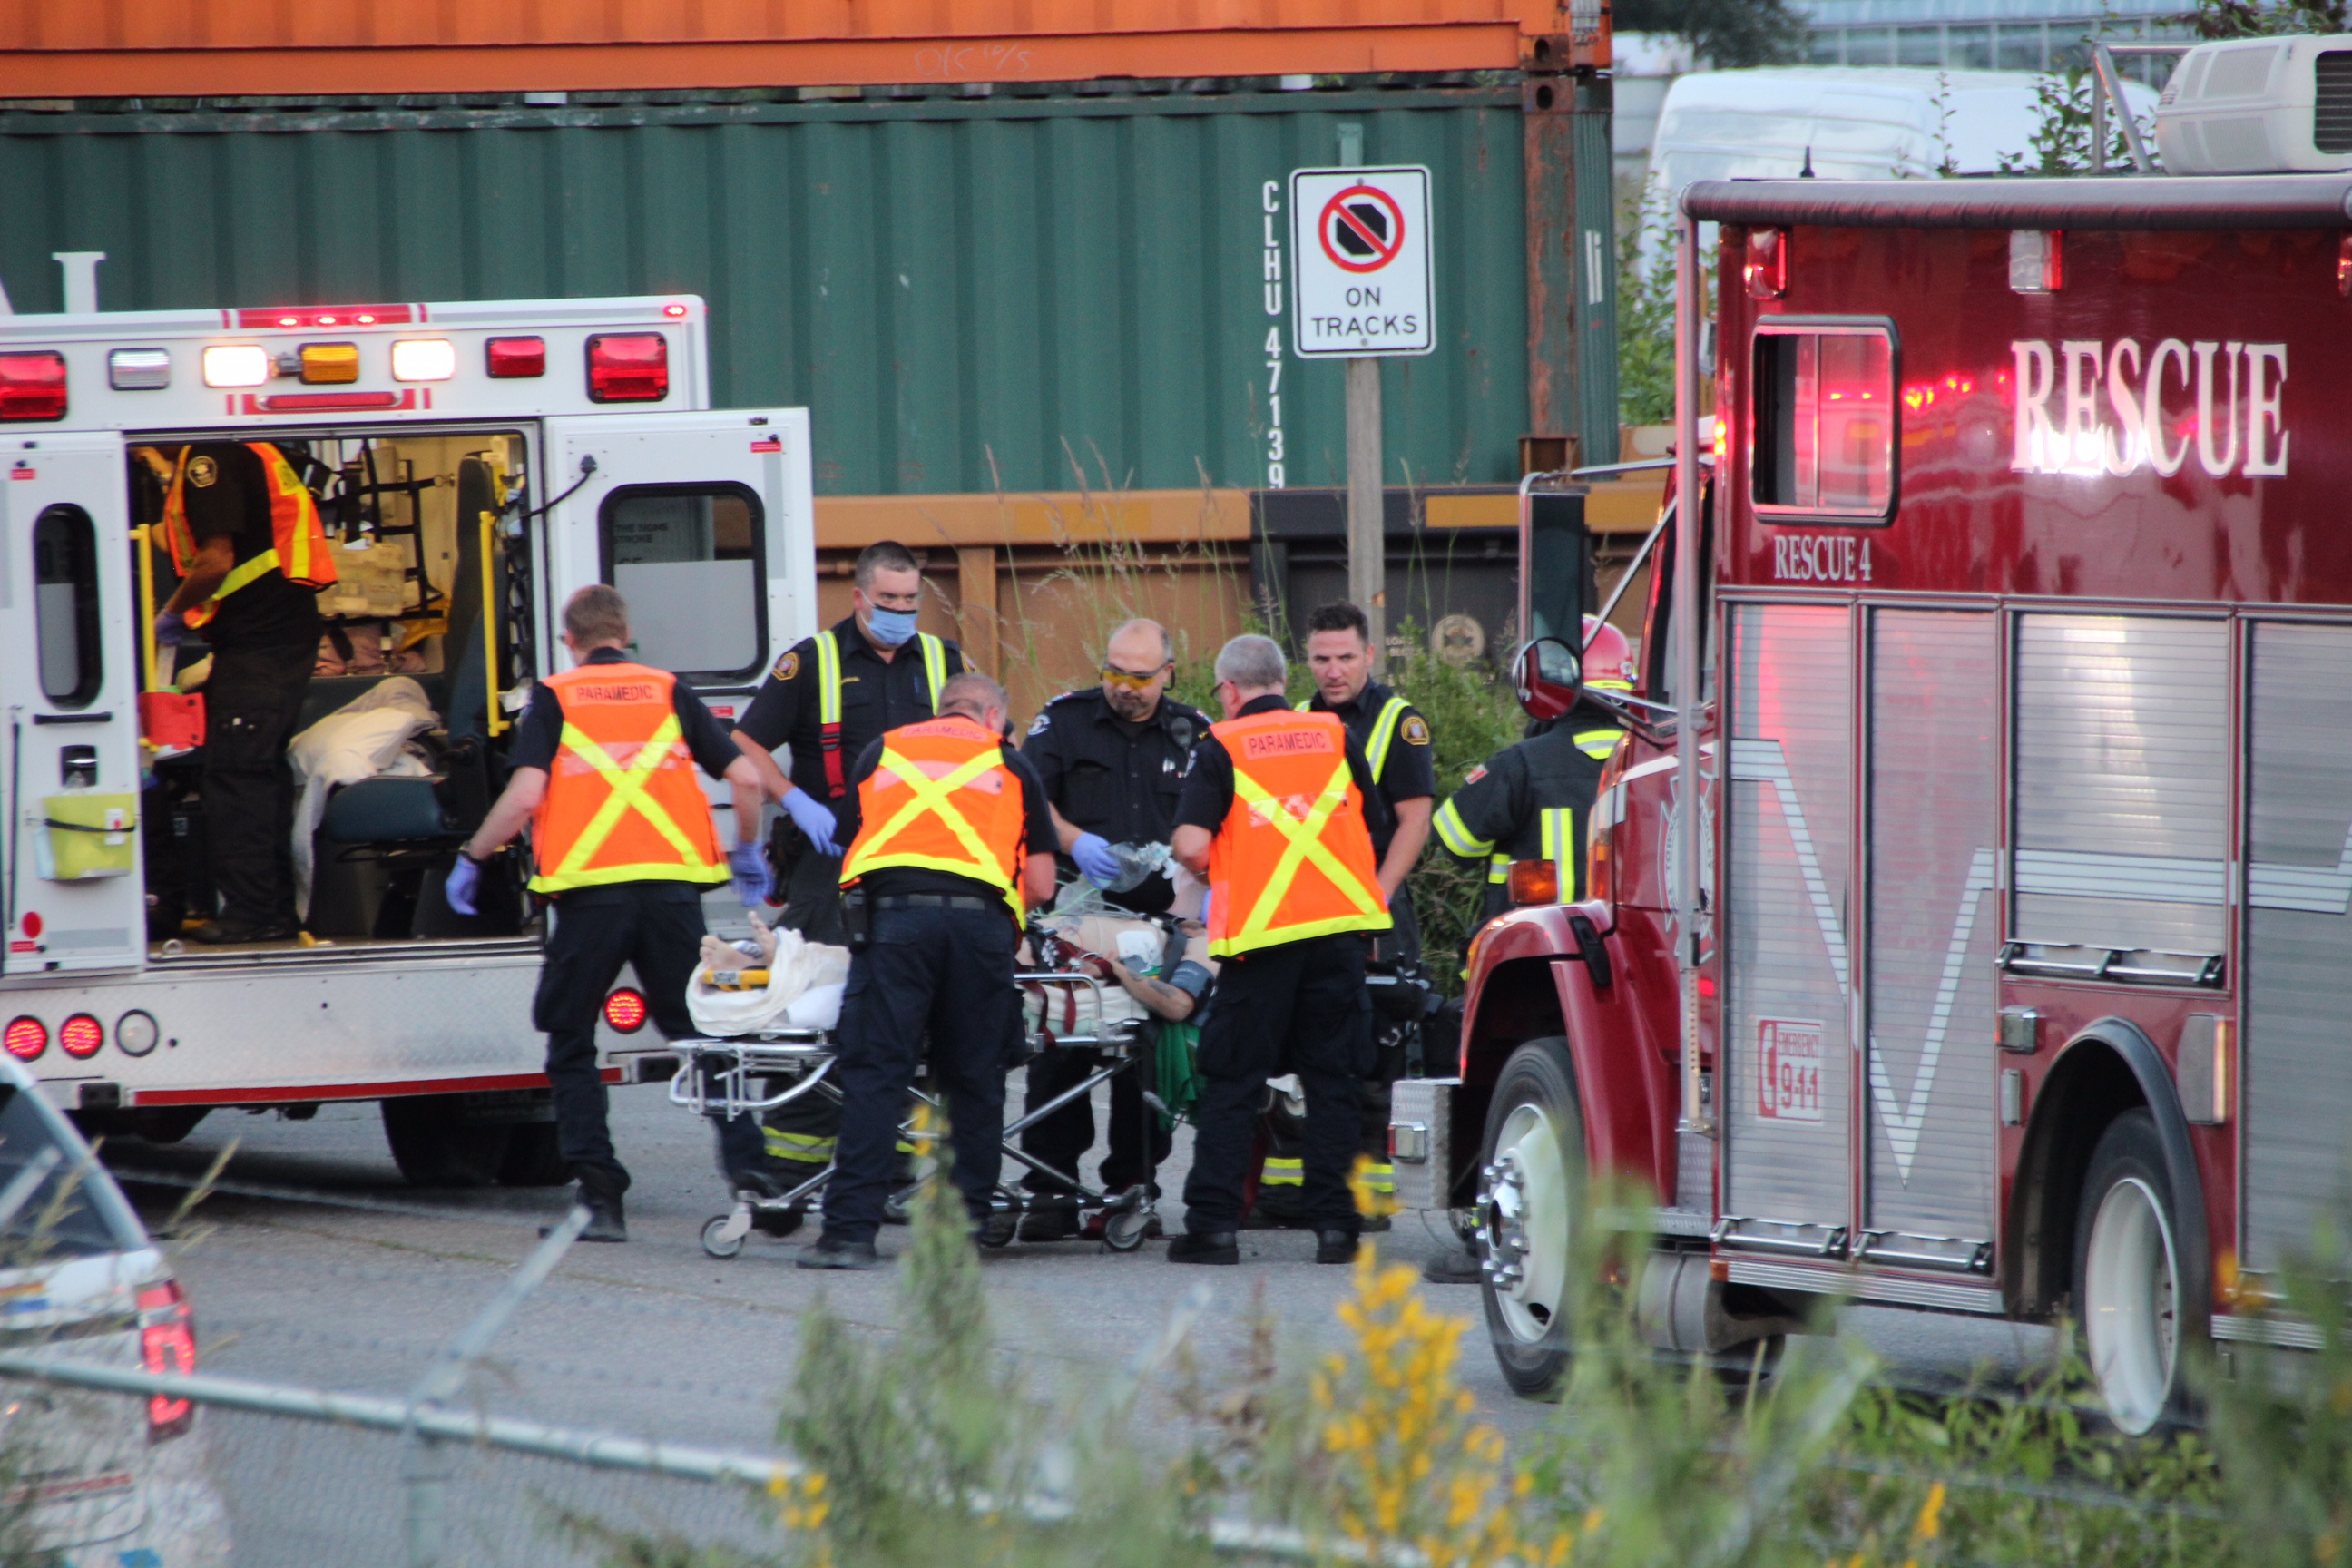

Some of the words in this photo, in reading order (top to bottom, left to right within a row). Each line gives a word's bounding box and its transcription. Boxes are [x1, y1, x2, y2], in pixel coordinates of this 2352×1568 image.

[1263, 181, 1282, 315] CLHU
[1346, 287, 1380, 307] ON
[1311, 315, 1417, 337] TRACKS
[1265, 327, 1285, 489] 47139
[2010, 338, 2290, 478] RESCUE
[1774, 535, 1856, 581] RESCUE
[1859, 537, 1872, 581] 4
[576, 684, 653, 701] PARAMEDIC
[904, 725, 982, 740] PARAMEDIC
[1249, 731, 1326, 755] PARAMEDIC
